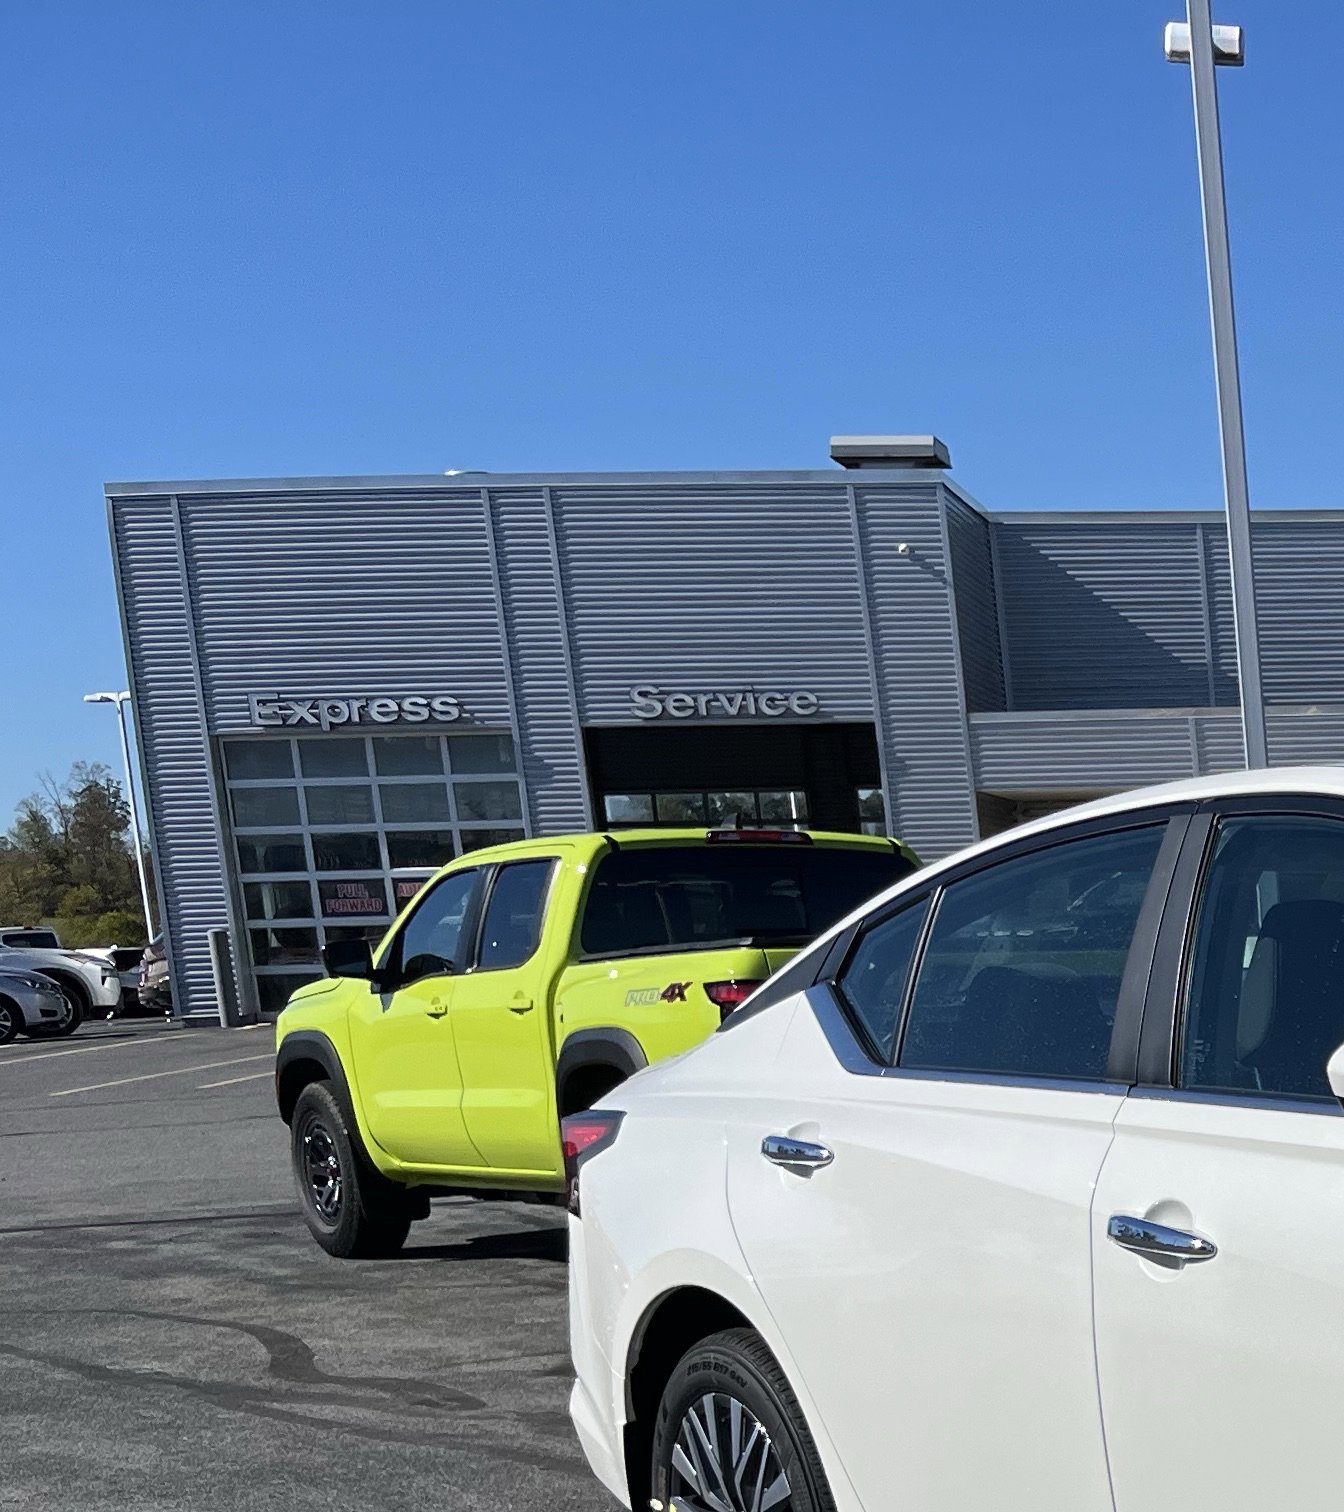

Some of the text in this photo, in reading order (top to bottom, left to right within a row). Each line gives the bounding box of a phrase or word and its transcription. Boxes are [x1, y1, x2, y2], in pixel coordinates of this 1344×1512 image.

[247, 692, 461, 731] Express
[629, 684, 820, 719] Service
[336, 883, 369, 898] PULL
[325, 897, 383, 913] FORWARD
